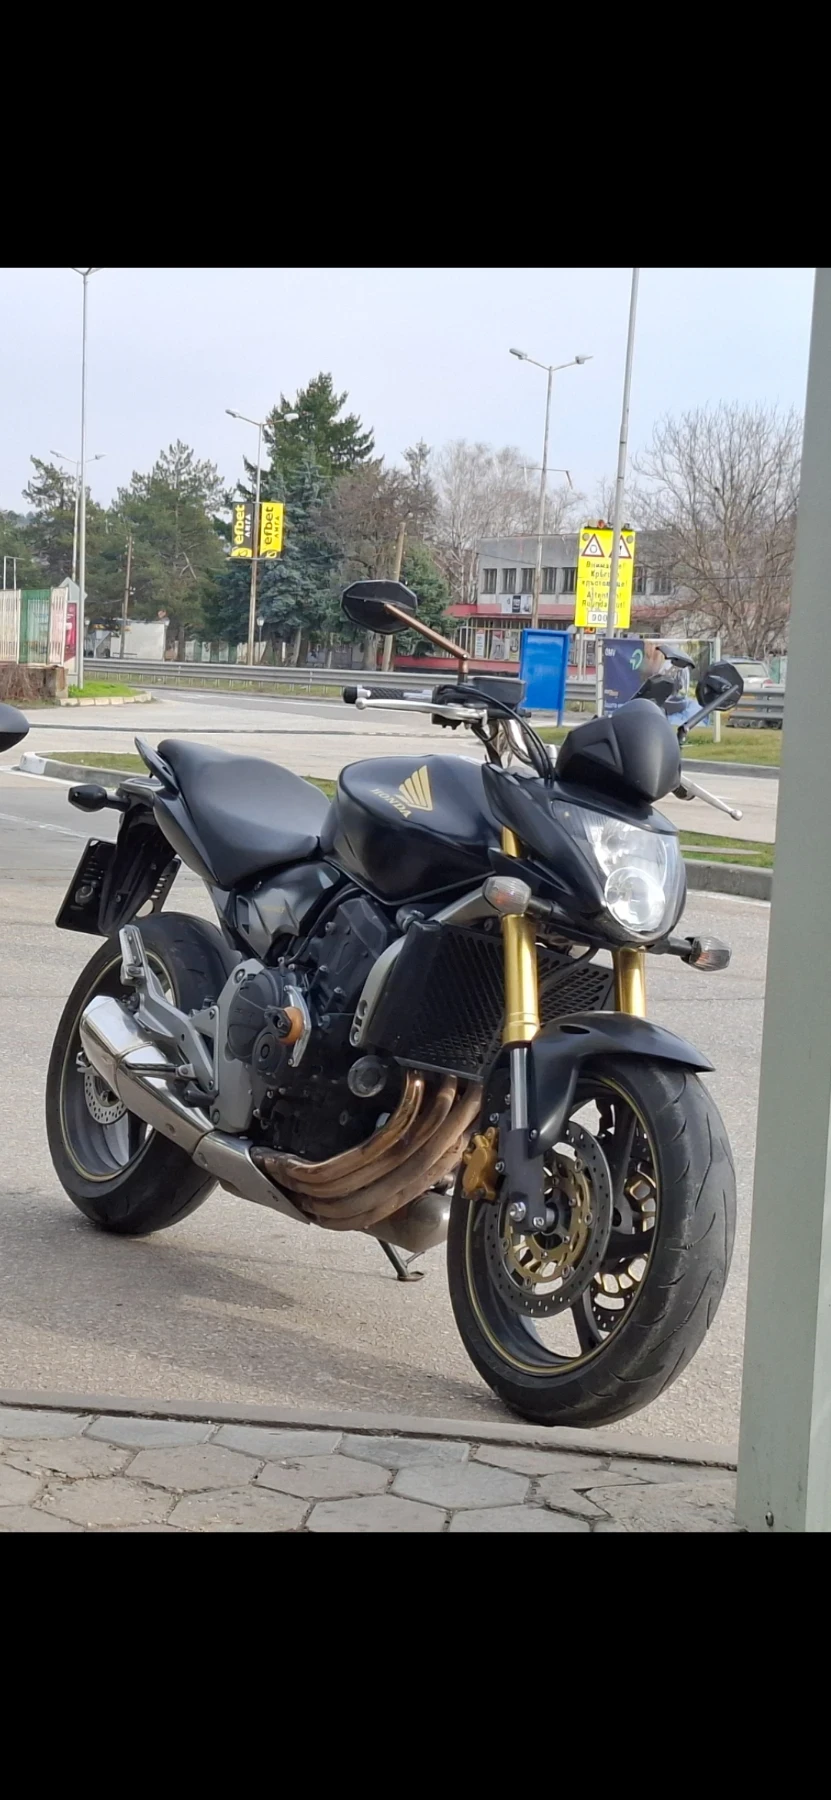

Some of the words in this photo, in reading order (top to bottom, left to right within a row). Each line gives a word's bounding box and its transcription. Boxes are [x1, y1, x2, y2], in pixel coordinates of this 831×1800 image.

[234, 504, 245, 545] efbet
[264, 506, 274, 545] efbet
[605, 648, 616, 657] OMV
[370, 788, 412, 818] HONDA
